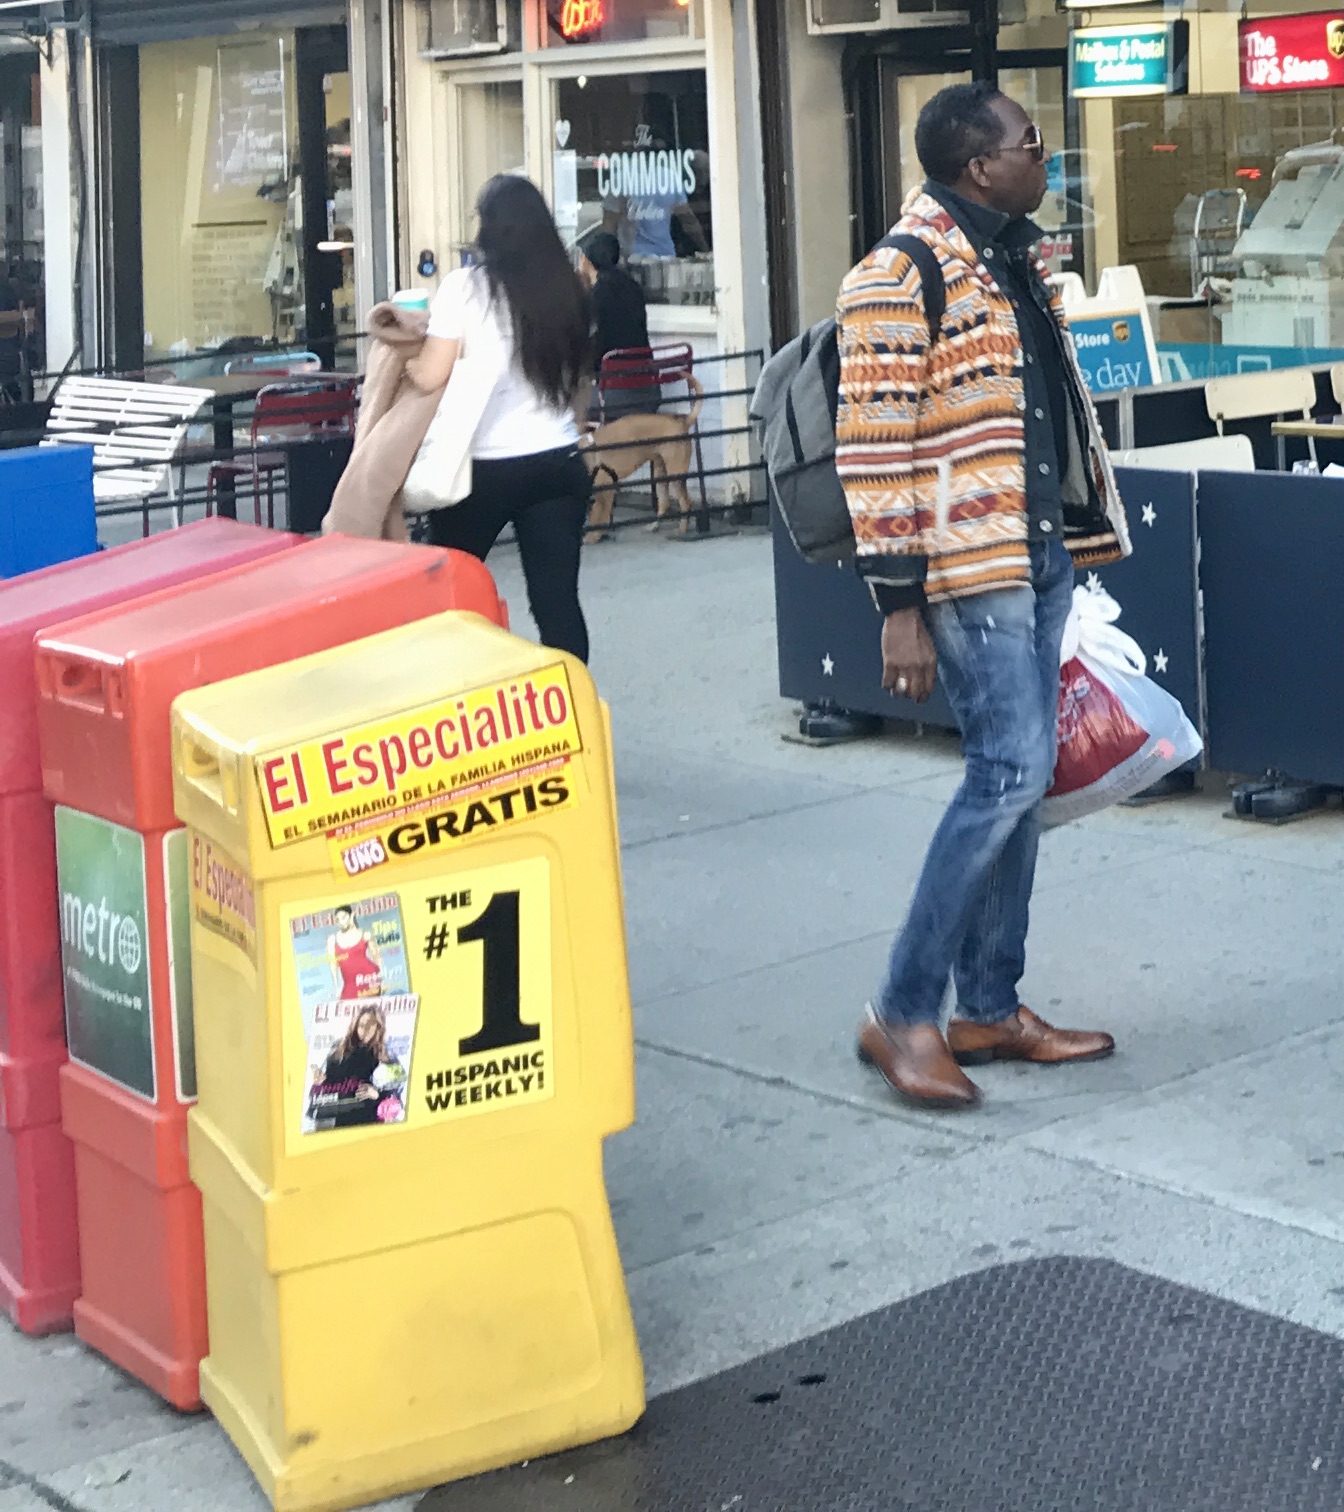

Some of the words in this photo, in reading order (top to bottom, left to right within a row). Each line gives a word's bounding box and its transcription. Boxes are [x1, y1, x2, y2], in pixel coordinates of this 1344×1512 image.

[1244, 31, 1276, 57] The
[1246, 57, 1281, 85] UPS
[1282, 55, 1329, 84] Store
[598, 148, 696, 198] COMMONS
[1074, 333, 1111, 349] Store
[1096, 357, 1142, 389] day
[263, 753, 308, 813] El
[322, 681, 567, 795] Especialito
[283, 825, 302, 840] EL
[308, 795, 397, 831] SEMANARIO
[402, 786, 422, 802] DE
[428, 779, 446, 794] LA
[450, 759, 506, 786] FAMILIA
[511, 739, 570, 766] HISPANA
[387, 775, 570, 855] GRATIS
[343, 841, 385, 875] UNO
[426, 889, 472, 914] THE
[426, 1051, 544, 1092] HISPANIC
[425, 1071, 545, 1113] WEEKLY!
